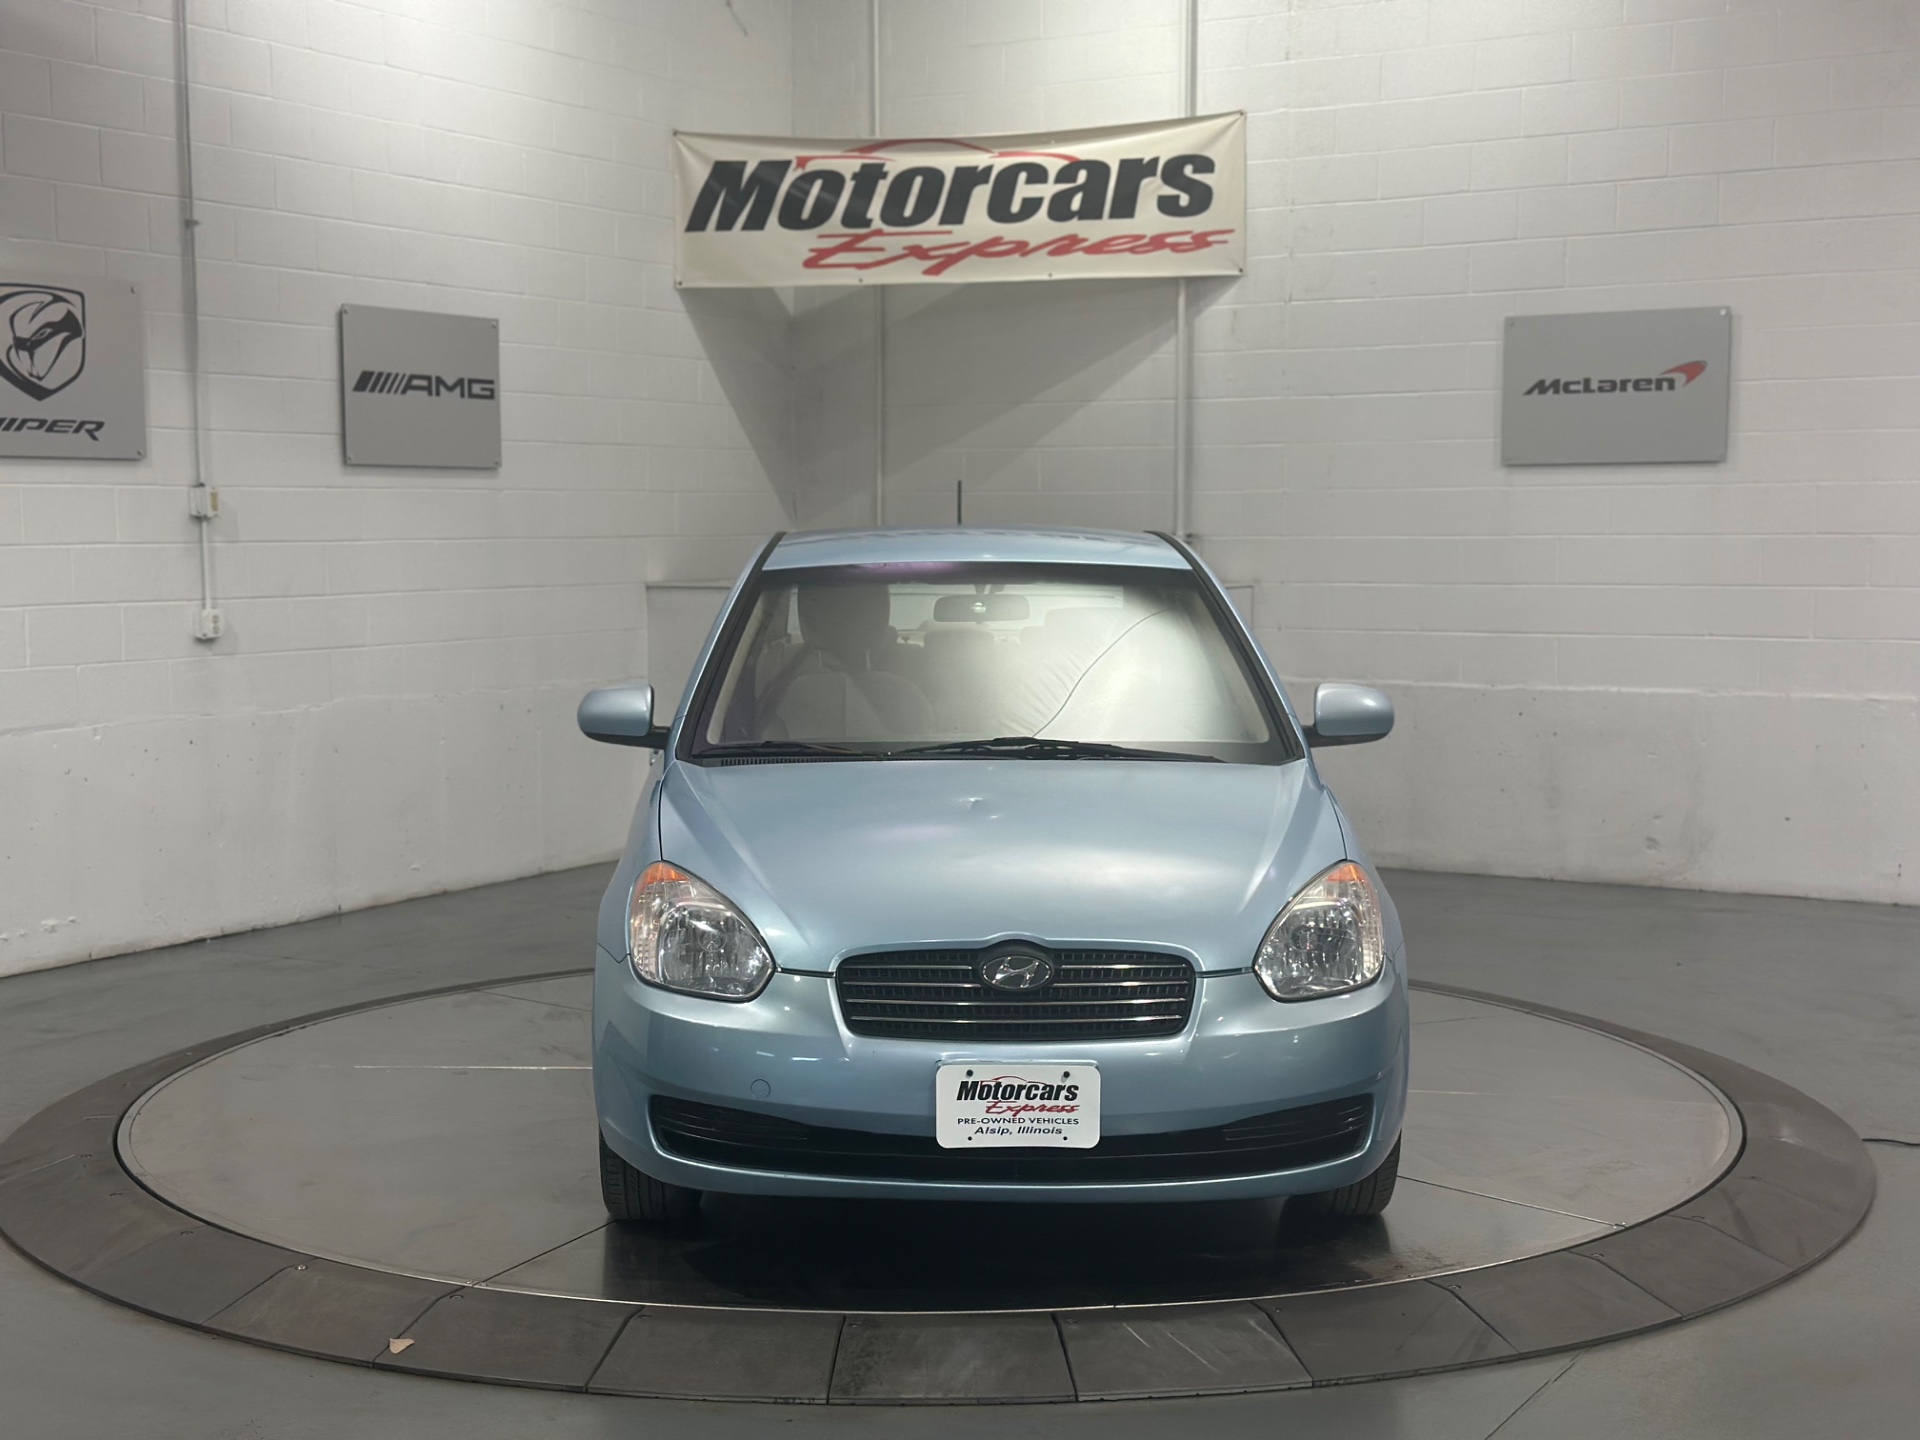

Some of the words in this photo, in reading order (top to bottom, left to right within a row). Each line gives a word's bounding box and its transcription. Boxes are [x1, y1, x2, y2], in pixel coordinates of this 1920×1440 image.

[684, 153, 1216, 233] Motorcars
[802, 229, 1235, 276] Express
[400, 373, 495, 400] AMG
[1522, 377, 1676, 396] McLaren
[956, 1080, 1080, 1101] Motorcars
[985, 1100, 1080, 1117] Express
[957, 1117, 1026, 1125] PRE-OWNED
[1029, 1117, 1080, 1125] VEHICLES
[974, 1126, 1013, 1136] Alsip,
[1017, 1126, 1063, 1135] Illinois
